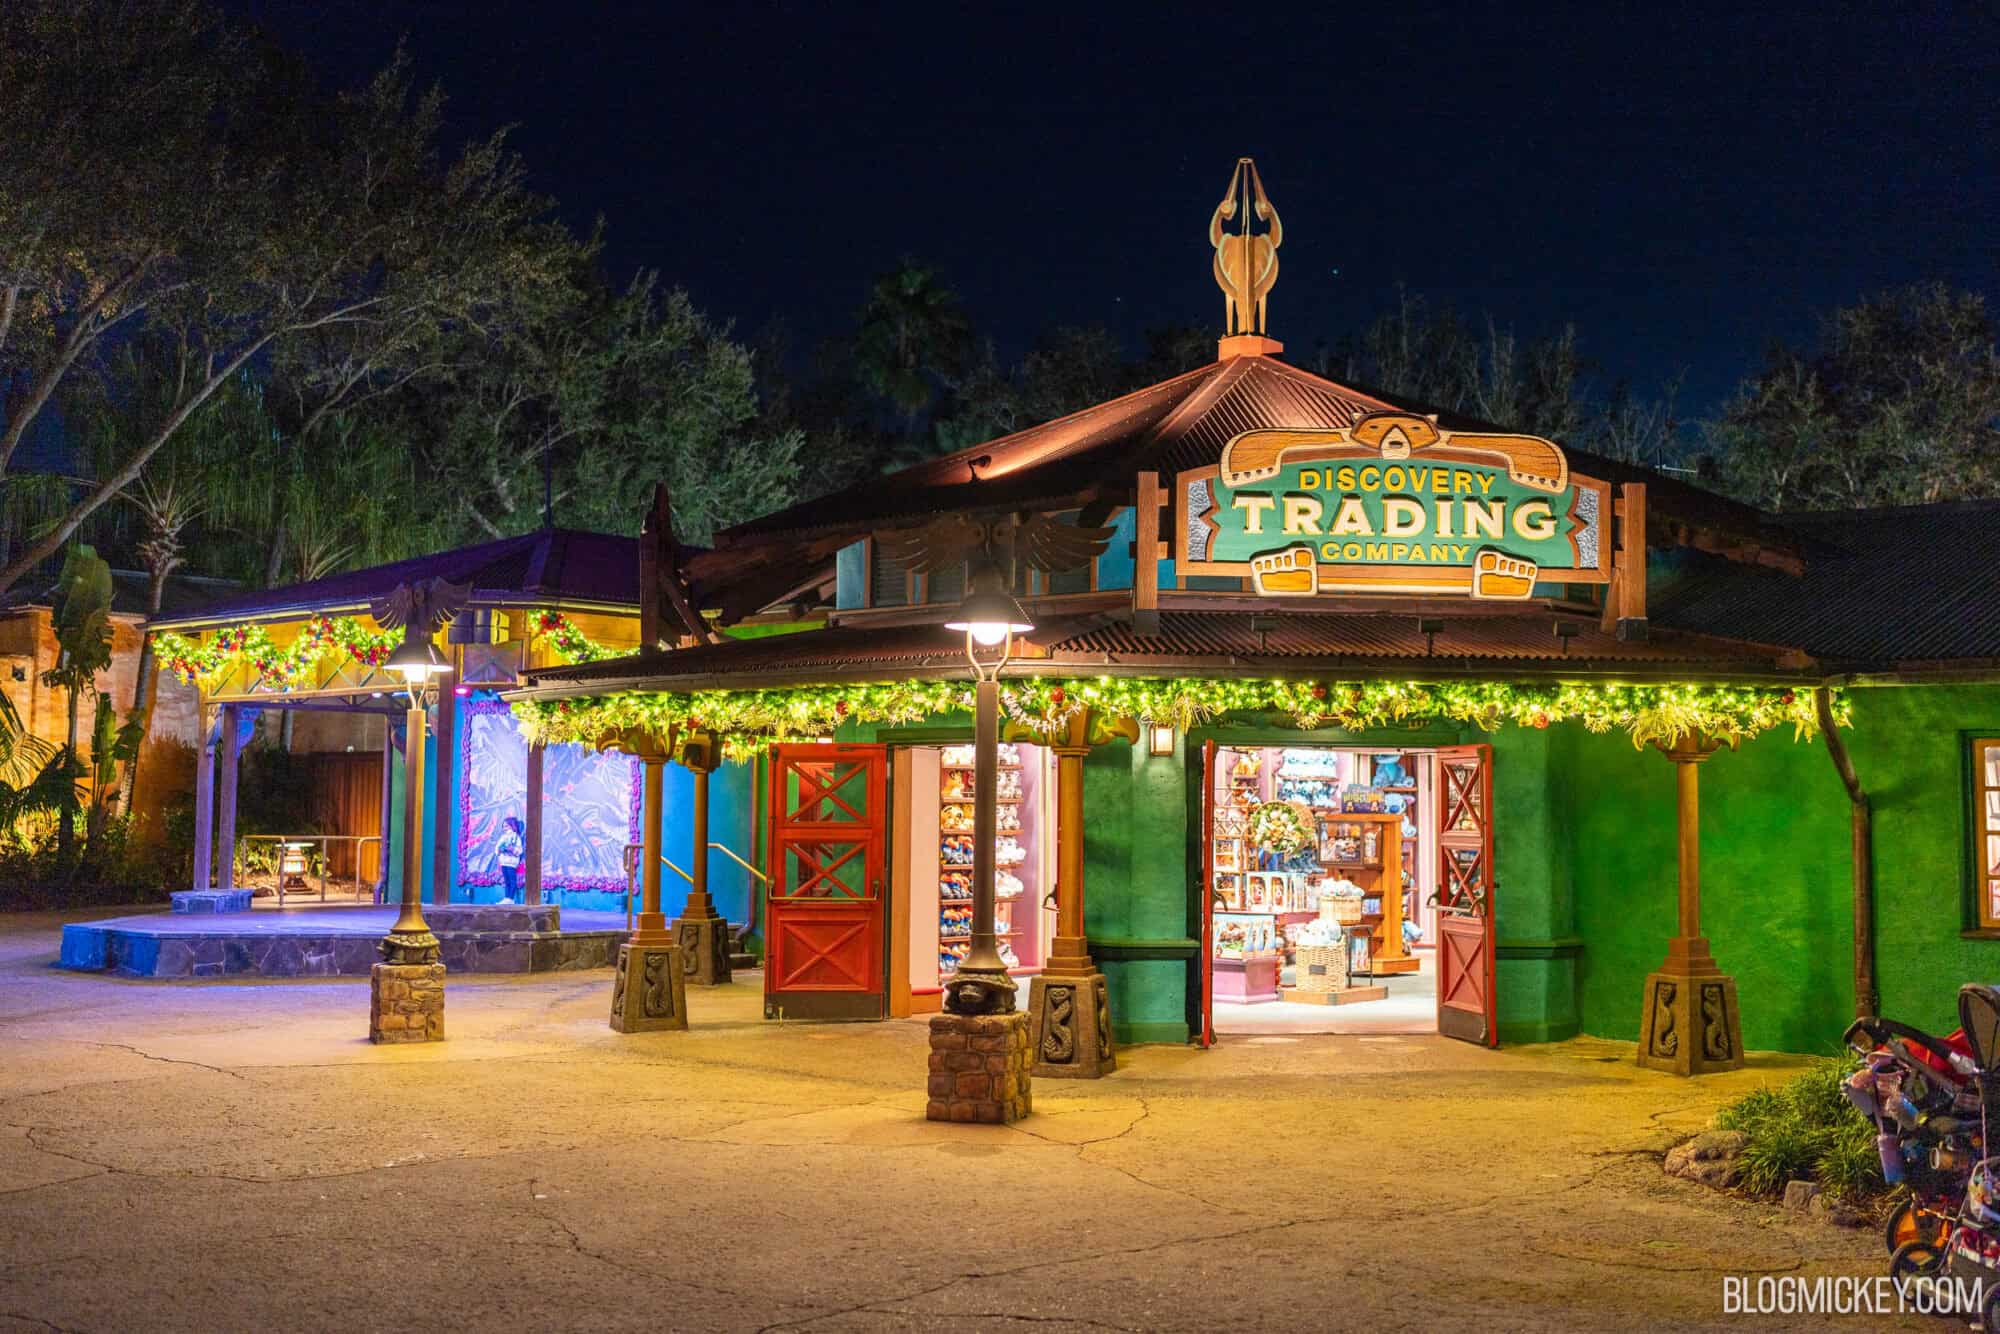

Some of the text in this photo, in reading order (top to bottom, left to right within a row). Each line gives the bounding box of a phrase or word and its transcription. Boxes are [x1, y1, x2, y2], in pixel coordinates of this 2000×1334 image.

[1299, 467, 1495, 494] DISCOVERY
[1231, 494, 1558, 539] TRADING
[1321, 543, 1471, 562] COMPANY
